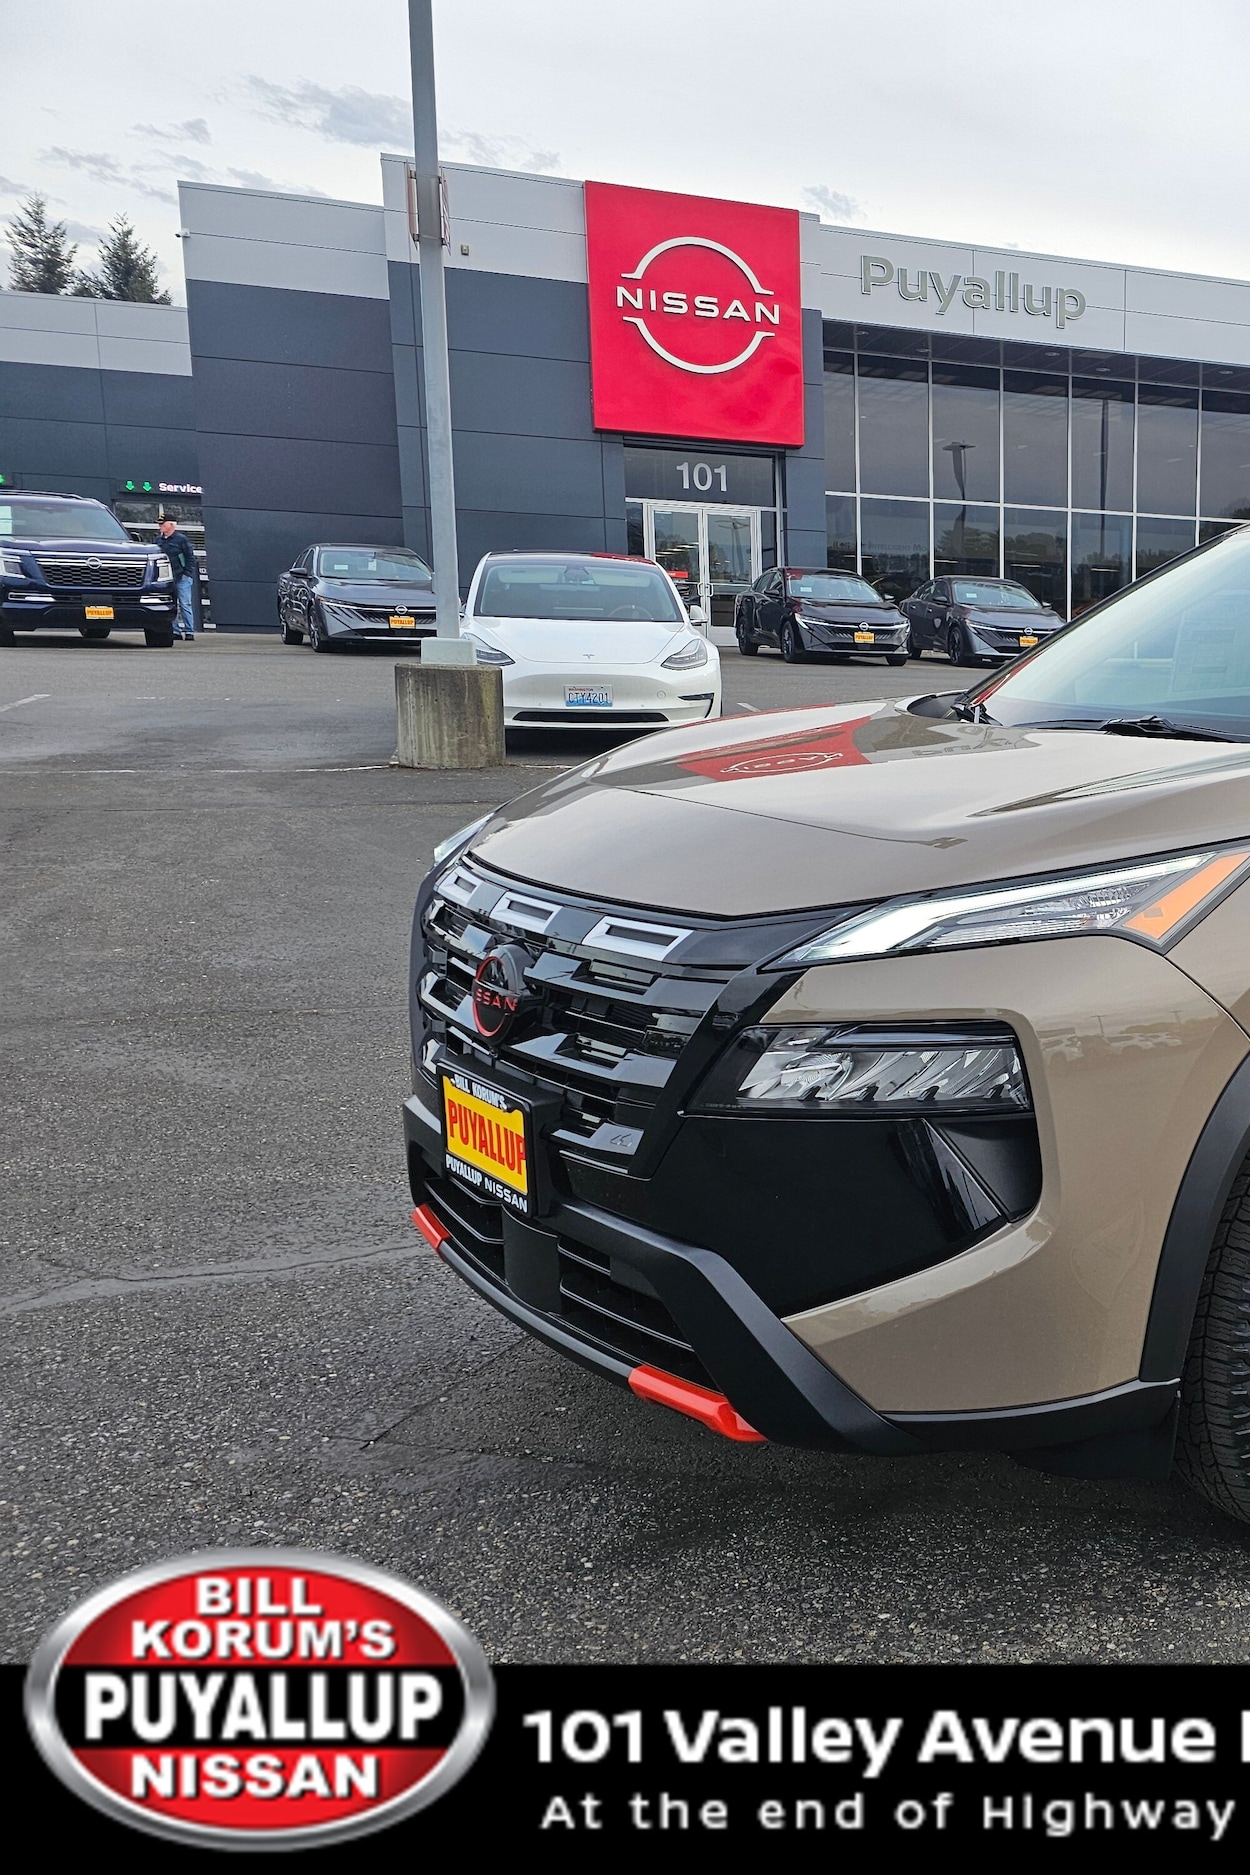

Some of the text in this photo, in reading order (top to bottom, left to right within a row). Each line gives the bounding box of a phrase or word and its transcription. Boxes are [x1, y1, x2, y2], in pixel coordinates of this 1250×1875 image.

[616, 286, 780, 326] NISSAN
[860, 254, 1087, 329] Puyallup
[158, 482, 204, 494] Service
[676, 461, 727, 492] 101
[568, 692, 608, 704] CTY4201
[454, 1073, 471, 1094] BILL
[447, 1098, 526, 1175] PUYALLUP
[446, 1154, 527, 1213] PUYALLUP NISSAN
